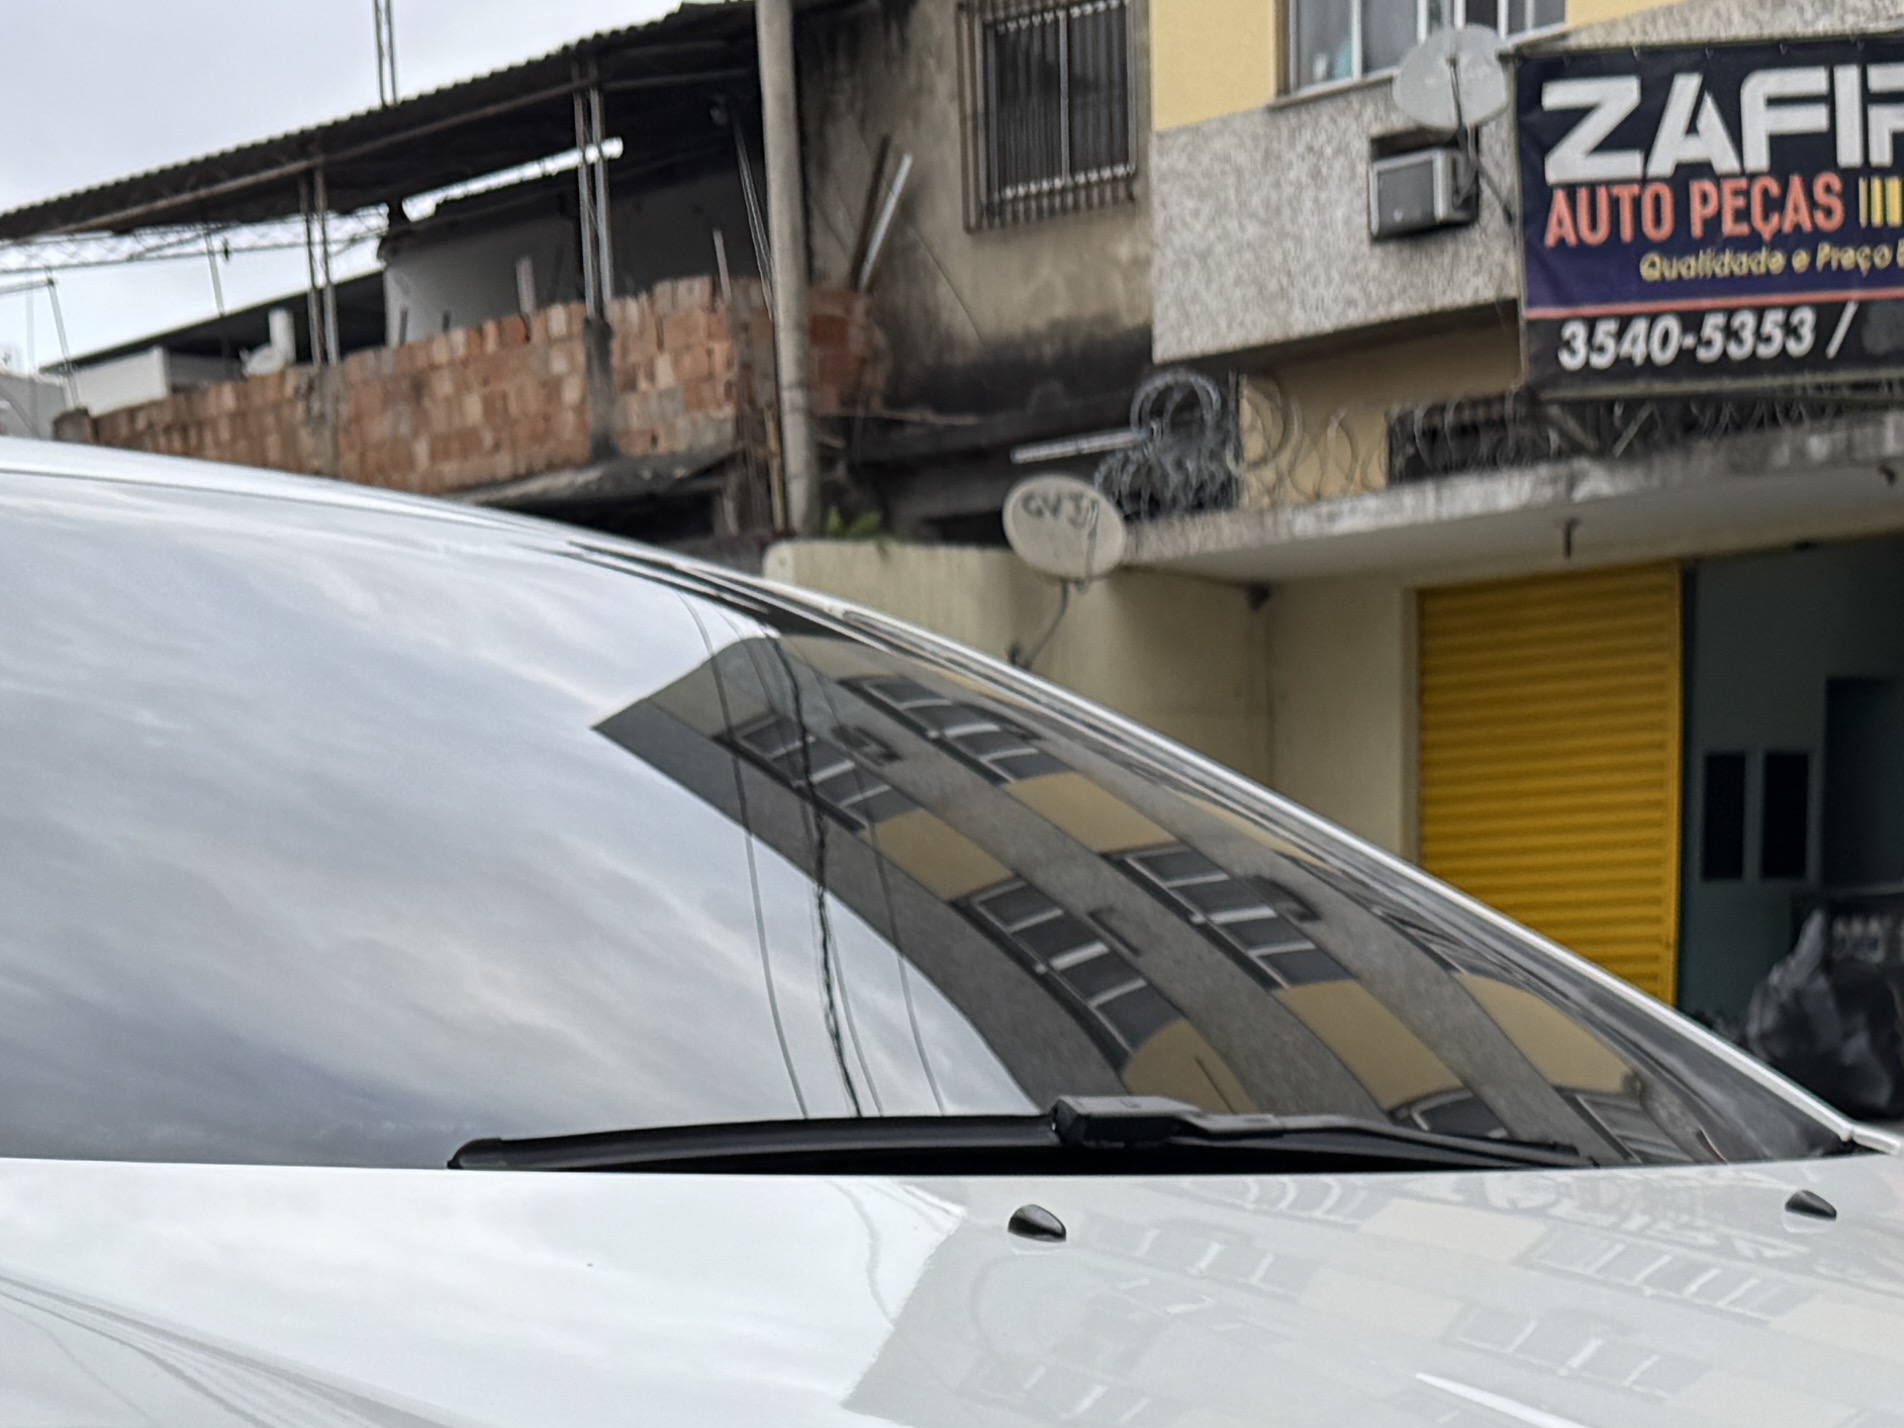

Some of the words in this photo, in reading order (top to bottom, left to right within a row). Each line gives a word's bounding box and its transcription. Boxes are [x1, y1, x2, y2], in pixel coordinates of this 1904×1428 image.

[1545, 181, 1675, 248] AUTO
[1689, 171, 1844, 242] PEÇAS
[1639, 246, 1786, 282] Qualidade
[1791, 249, 1811, 274] e
[1816, 241, 1893, 277] Preço
[1557, 305, 1817, 371] 3540-5353
